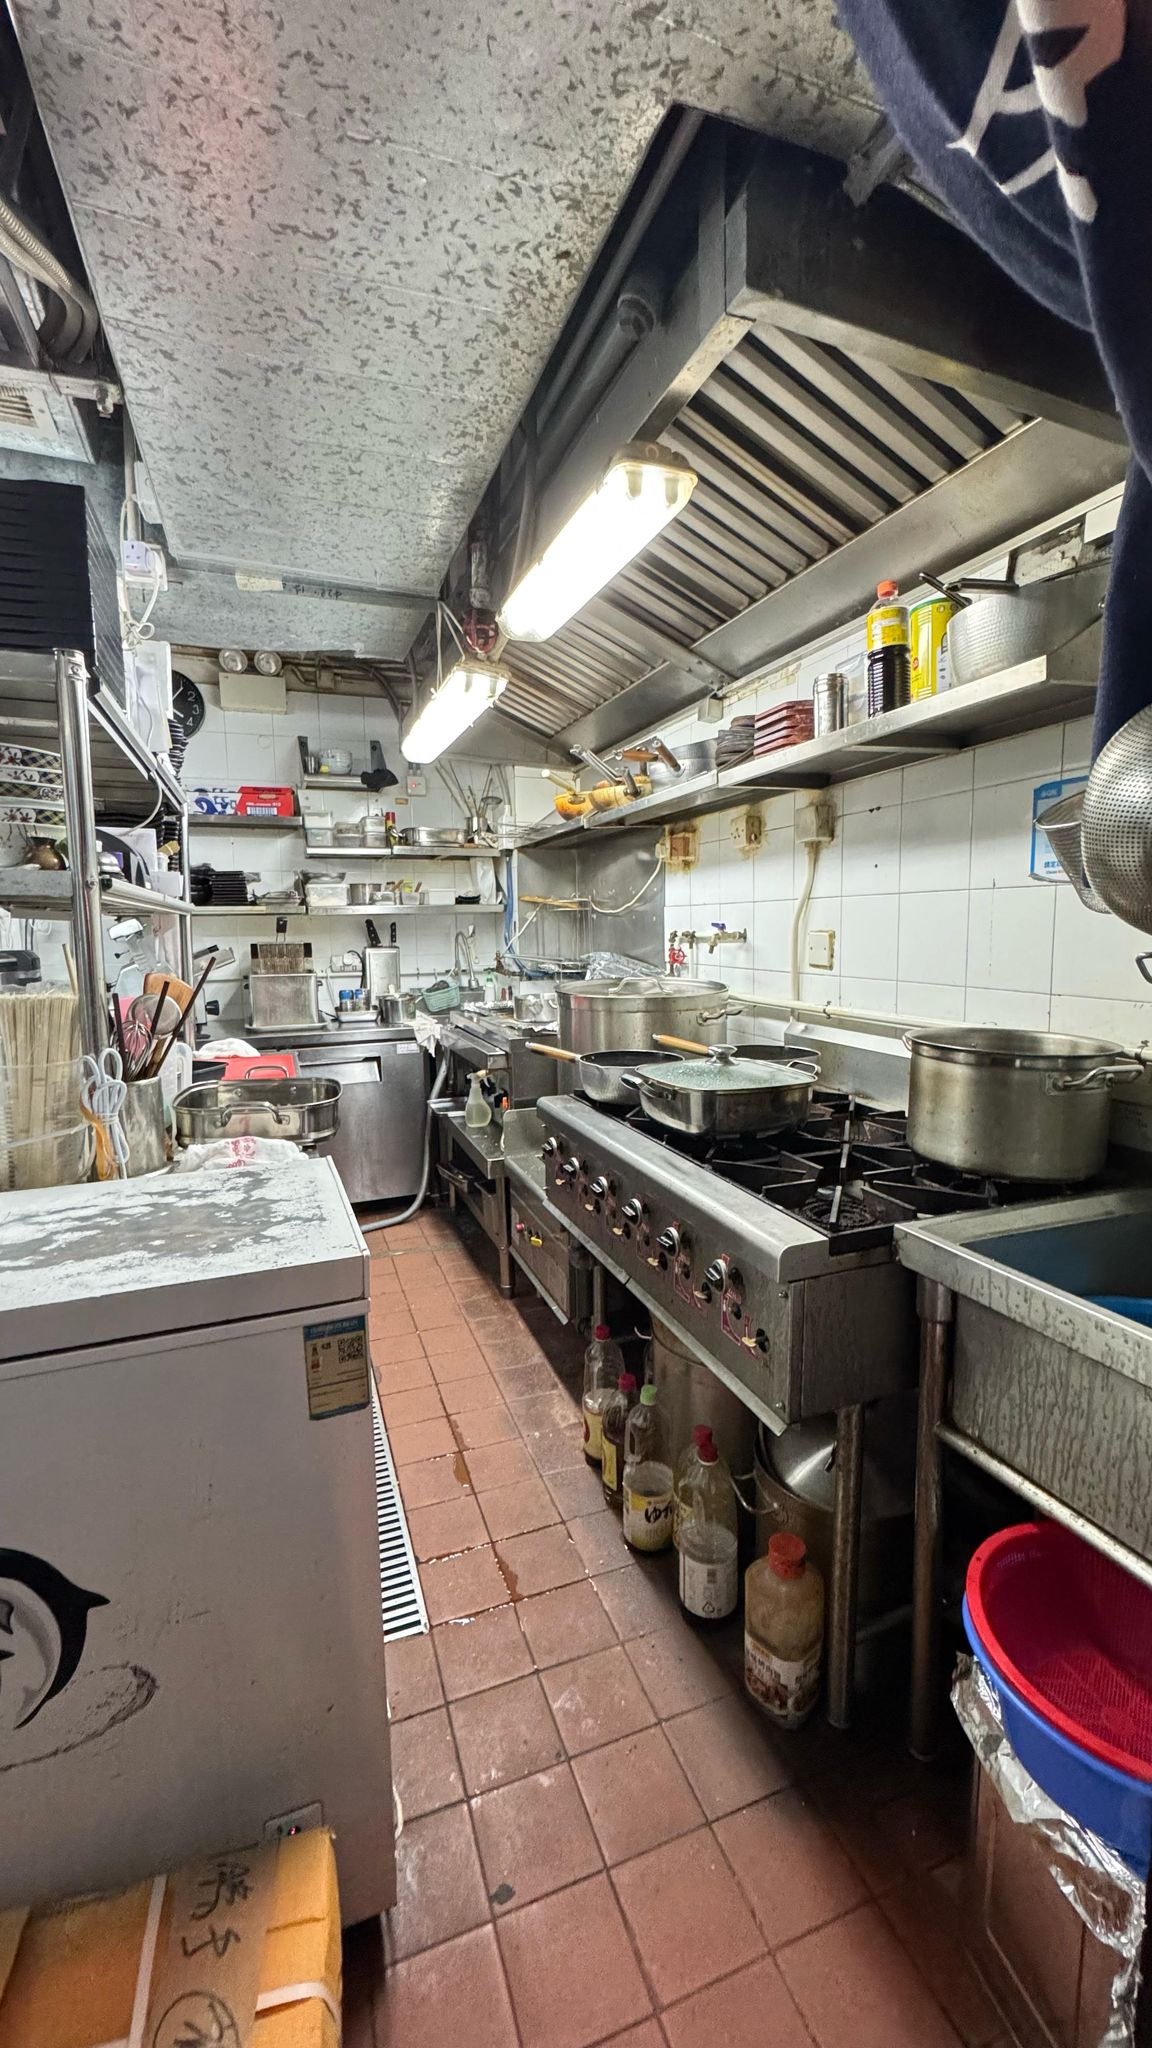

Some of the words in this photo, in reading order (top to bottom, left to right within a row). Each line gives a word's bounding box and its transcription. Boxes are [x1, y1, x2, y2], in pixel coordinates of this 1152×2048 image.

[187, 691, 196, 702] 2
[192, 704, 200, 715] 3
[186, 716, 194, 727] 4
